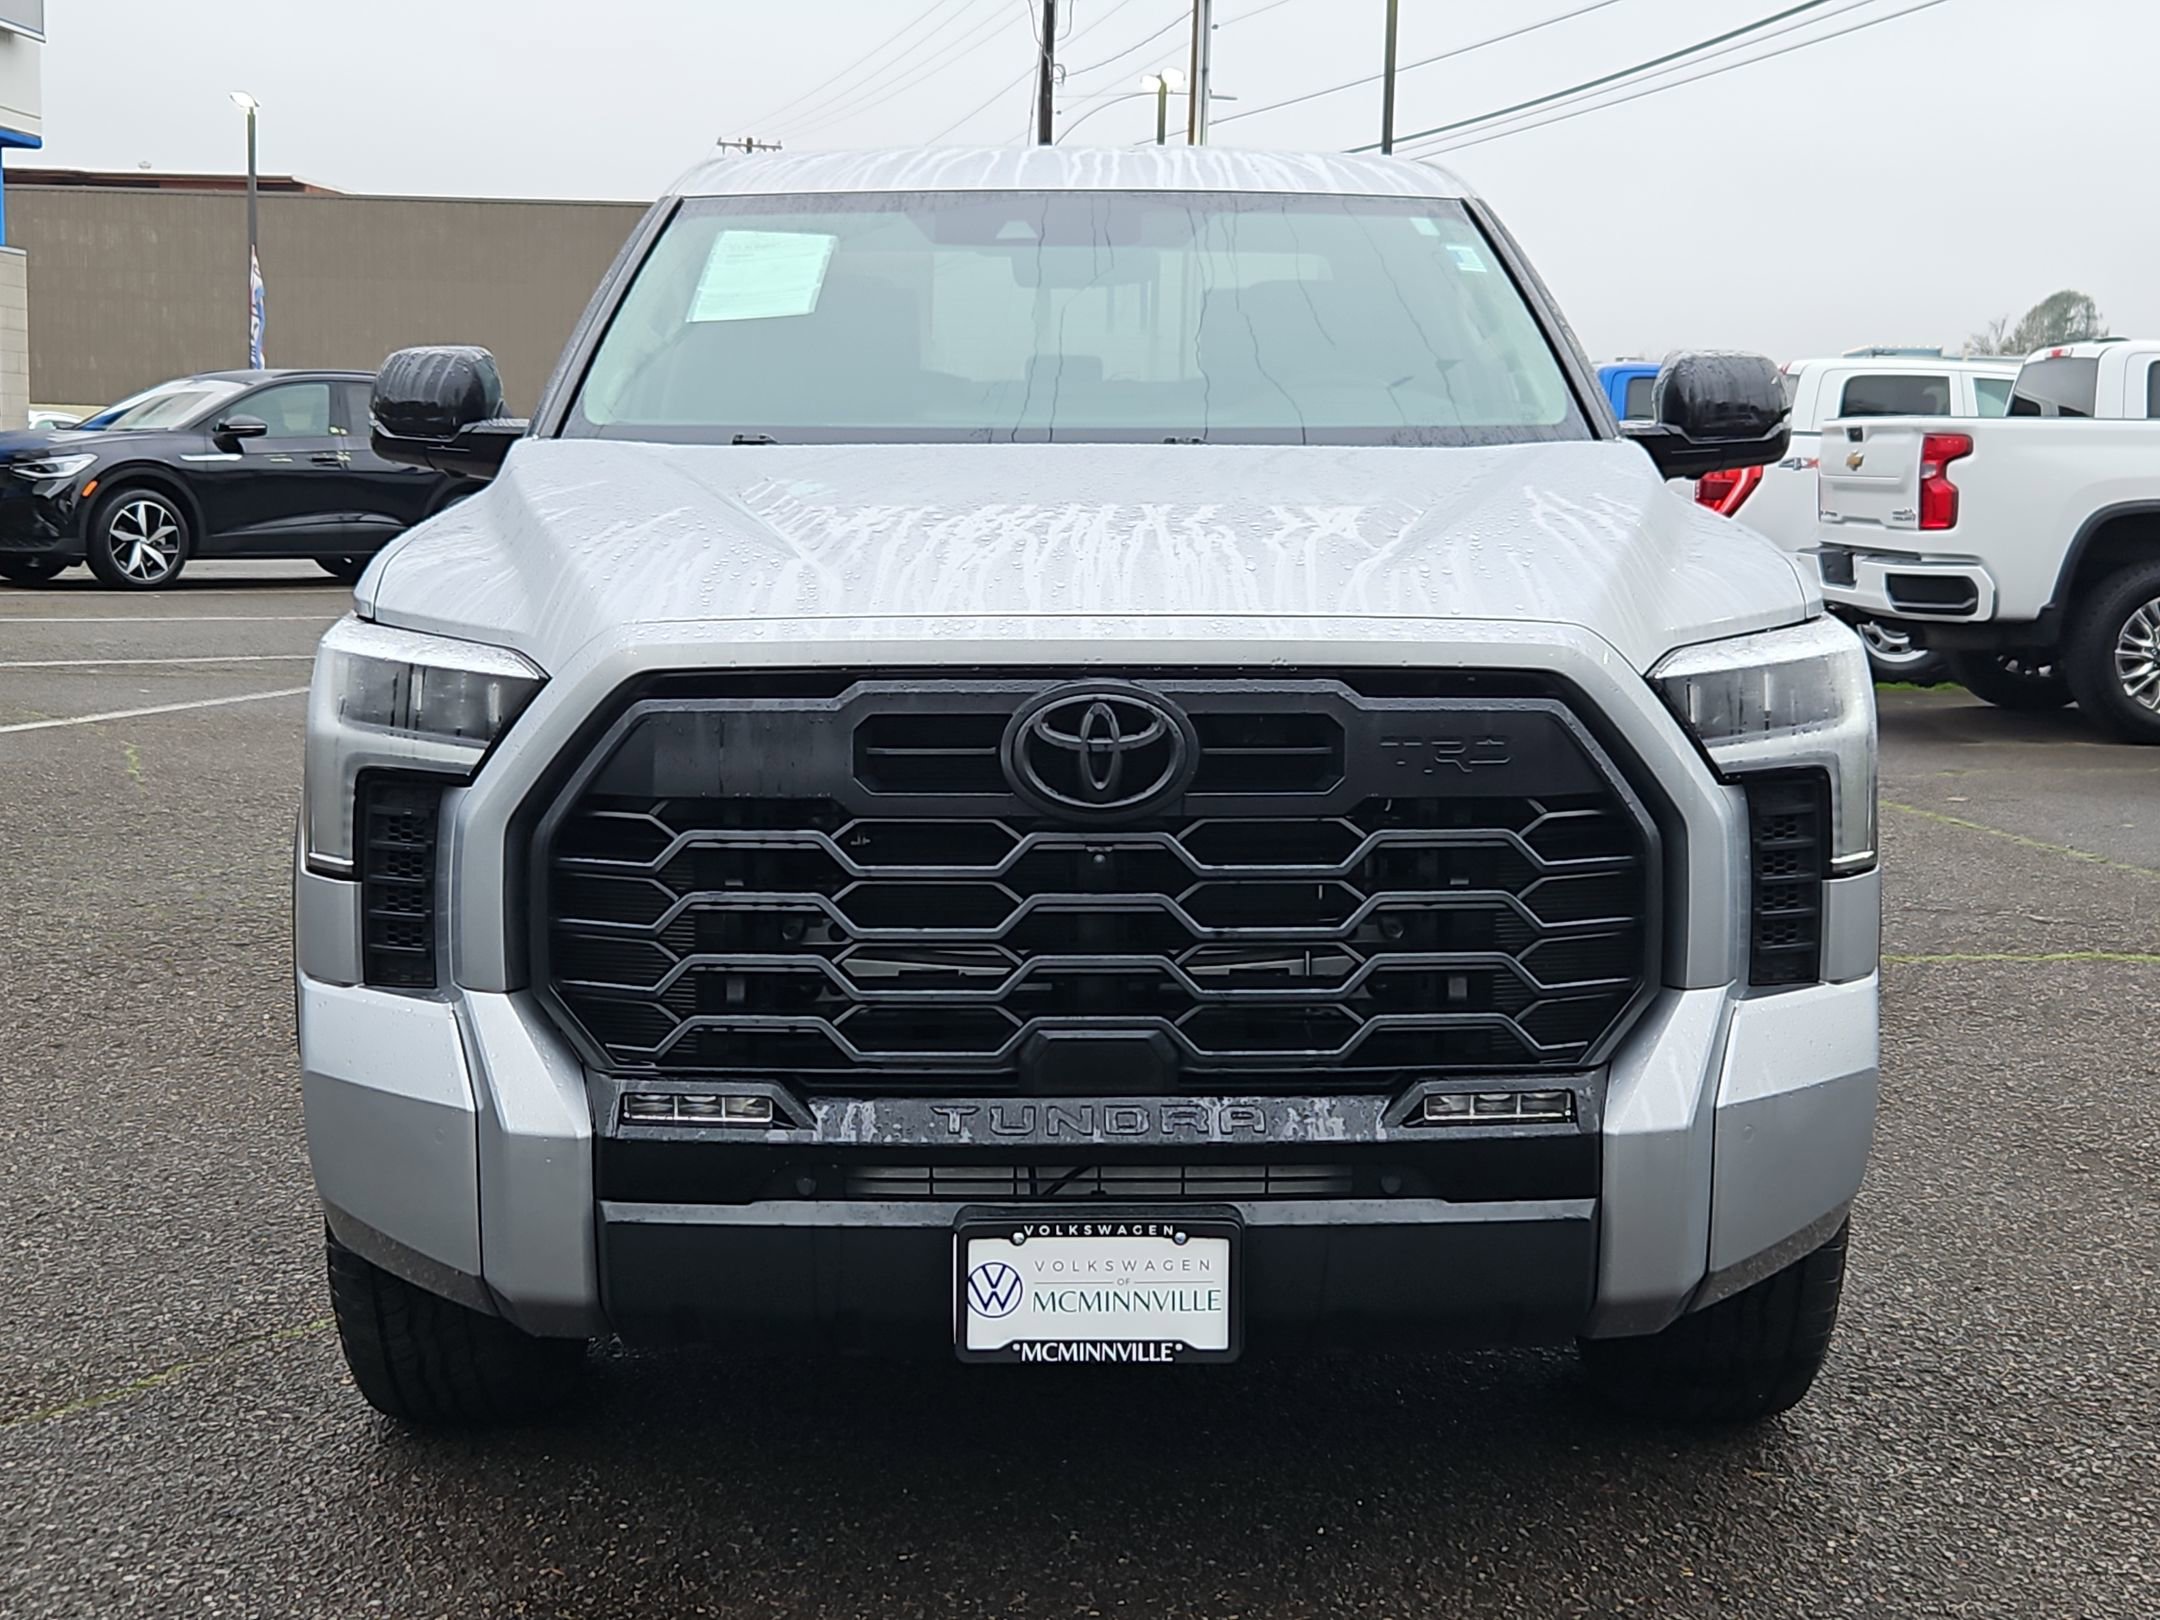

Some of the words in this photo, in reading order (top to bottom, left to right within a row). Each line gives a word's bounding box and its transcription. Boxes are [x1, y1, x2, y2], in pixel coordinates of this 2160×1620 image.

[1380, 736, 1511, 773] TRD
[930, 1105, 1267, 1136] TUNDRA
[1023, 1224, 1175, 1236] VOLKSWAGEN
[1033, 1259, 1212, 1272] VOLKSWAGEN
[1116, 1277, 1131, 1286] OF
[1032, 1290, 1222, 1312] MCMINNVILLE
[1021, 1342, 1174, 1362] MCMINNVILLE
